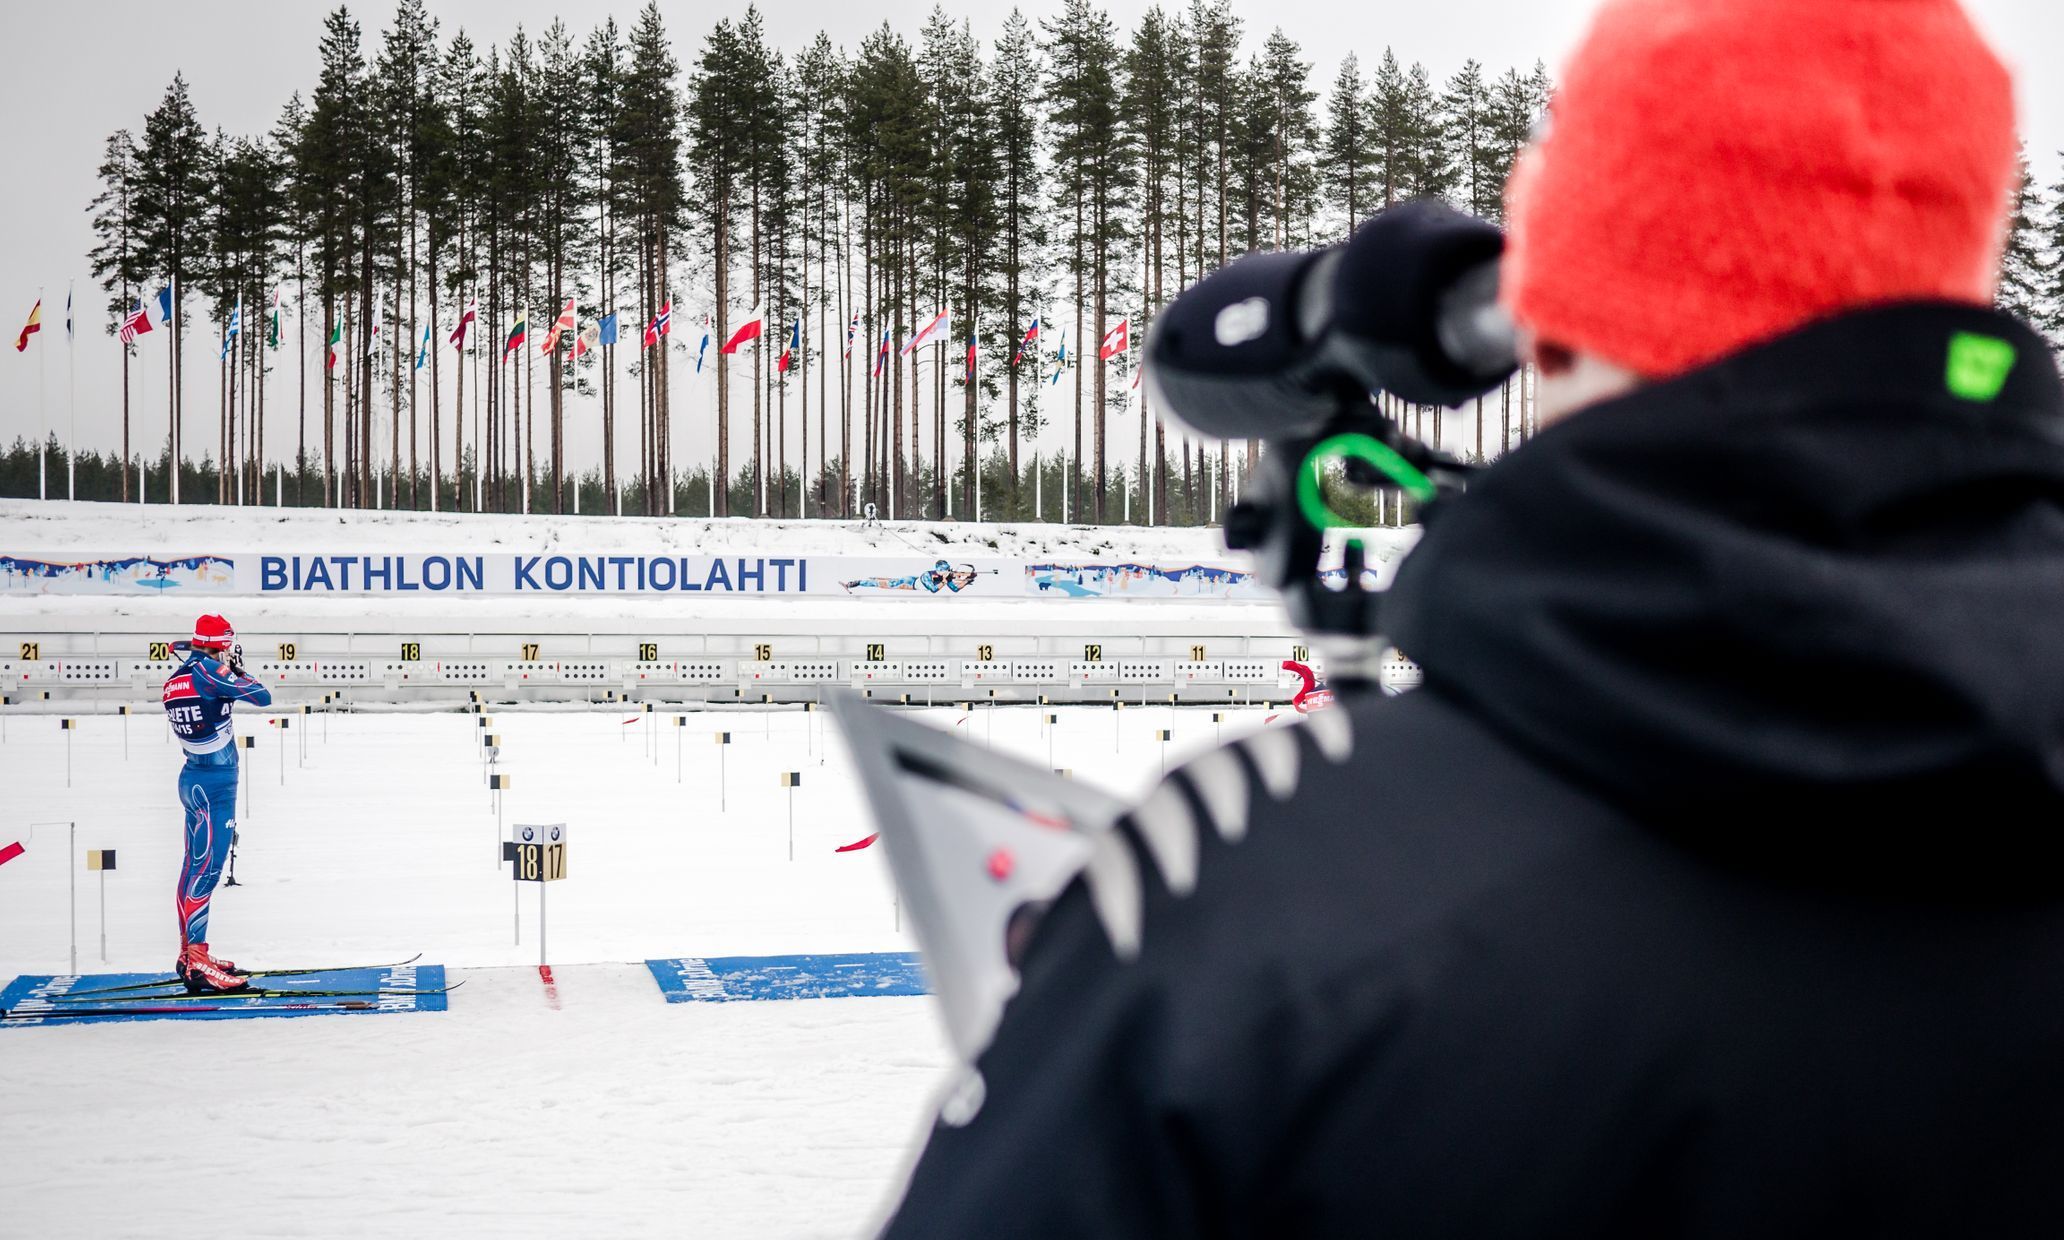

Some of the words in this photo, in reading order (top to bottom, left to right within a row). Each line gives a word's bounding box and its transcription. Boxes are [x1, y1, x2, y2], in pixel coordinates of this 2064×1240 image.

[261, 556, 484, 591] BIATHLON
[514, 556, 807, 592] KONTIOLAHTI
[22, 643, 38, 660] 21
[150, 643, 169, 660] 20
[280, 643, 295, 660] 19
[402, 643, 419, 660] 18
[523, 644, 538, 660] 17
[640, 644, 657, 660] 16
[755, 645, 770, 660] 15
[868, 644, 884, 660] 14
[979, 645, 993, 660] 13
[1085, 645, 1101, 660] 12
[1192, 646, 1204, 660] 11
[1293, 645, 1309, 661] 10
[517, 844, 538, 880] 18
[548, 844, 563, 879] 17
